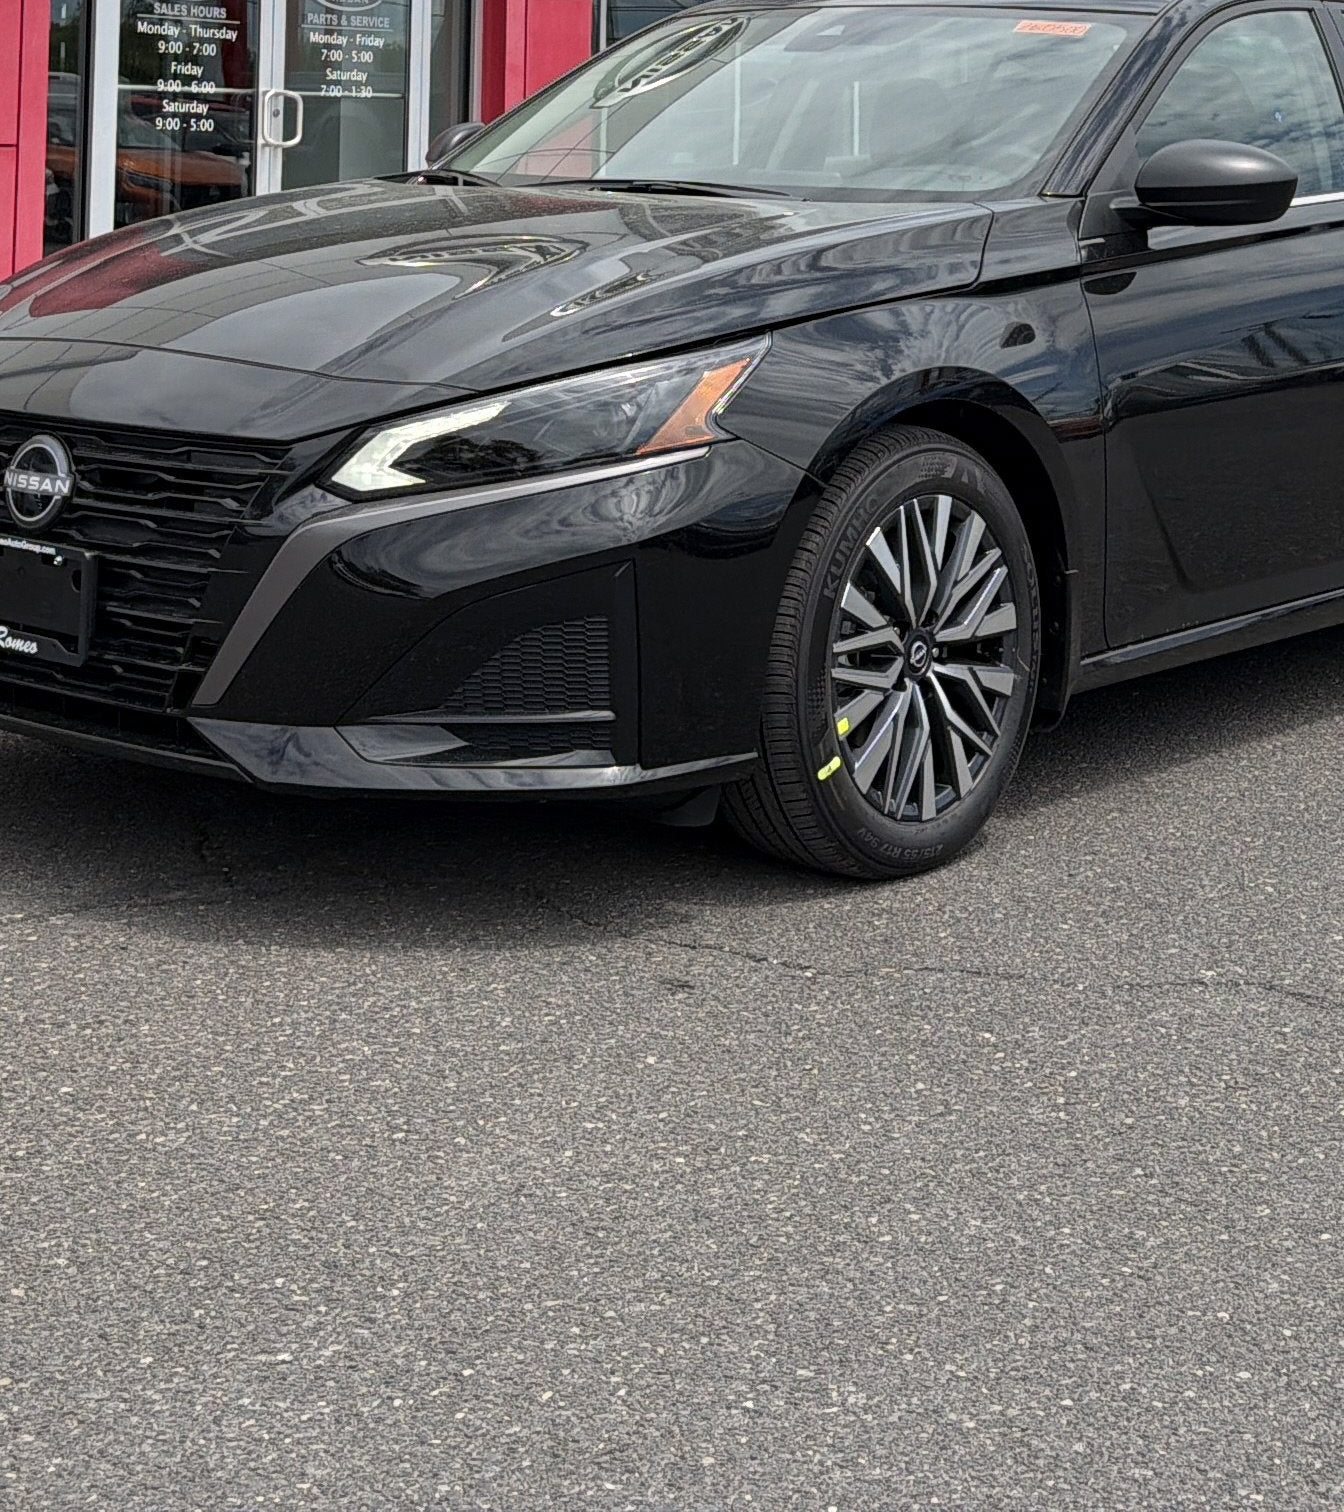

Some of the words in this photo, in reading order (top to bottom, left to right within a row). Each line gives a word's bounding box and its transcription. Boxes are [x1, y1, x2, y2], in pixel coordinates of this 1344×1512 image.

[153, 2, 188, 16] SALES
[190, 5, 227, 19] HOURS
[307, 13, 338, 26] PARTS
[340, 15, 348, 26] &
[350, 16, 390, 28] SERVICE
[137, 21, 181, 38] Monday
[189, 24, 238, 42] Thursday
[158, 40, 183, 54] 9:00
[192, 43, 217, 56] 7:00
[309, 32, 348, 47] Monday
[356, 34, 385, 48] Friday
[321, 49, 343, 61] 7:00
[351, 50, 374, 63] 5:00
[170, 61, 204, 78] Friday
[325, 68, 368, 84] Saturday
[157, 79, 182, 93] 9:00
[191, 81, 216, 94] 6:00
[320, 85, 343, 97] 7:00
[351, 86, 373, 98] 1:30
[162, 99, 209, 116] Saturday
[155, 117, 181, 131] 9:00
[189, 119, 214, 132] 5:00
[4, 470, 70, 494] NISSAN
